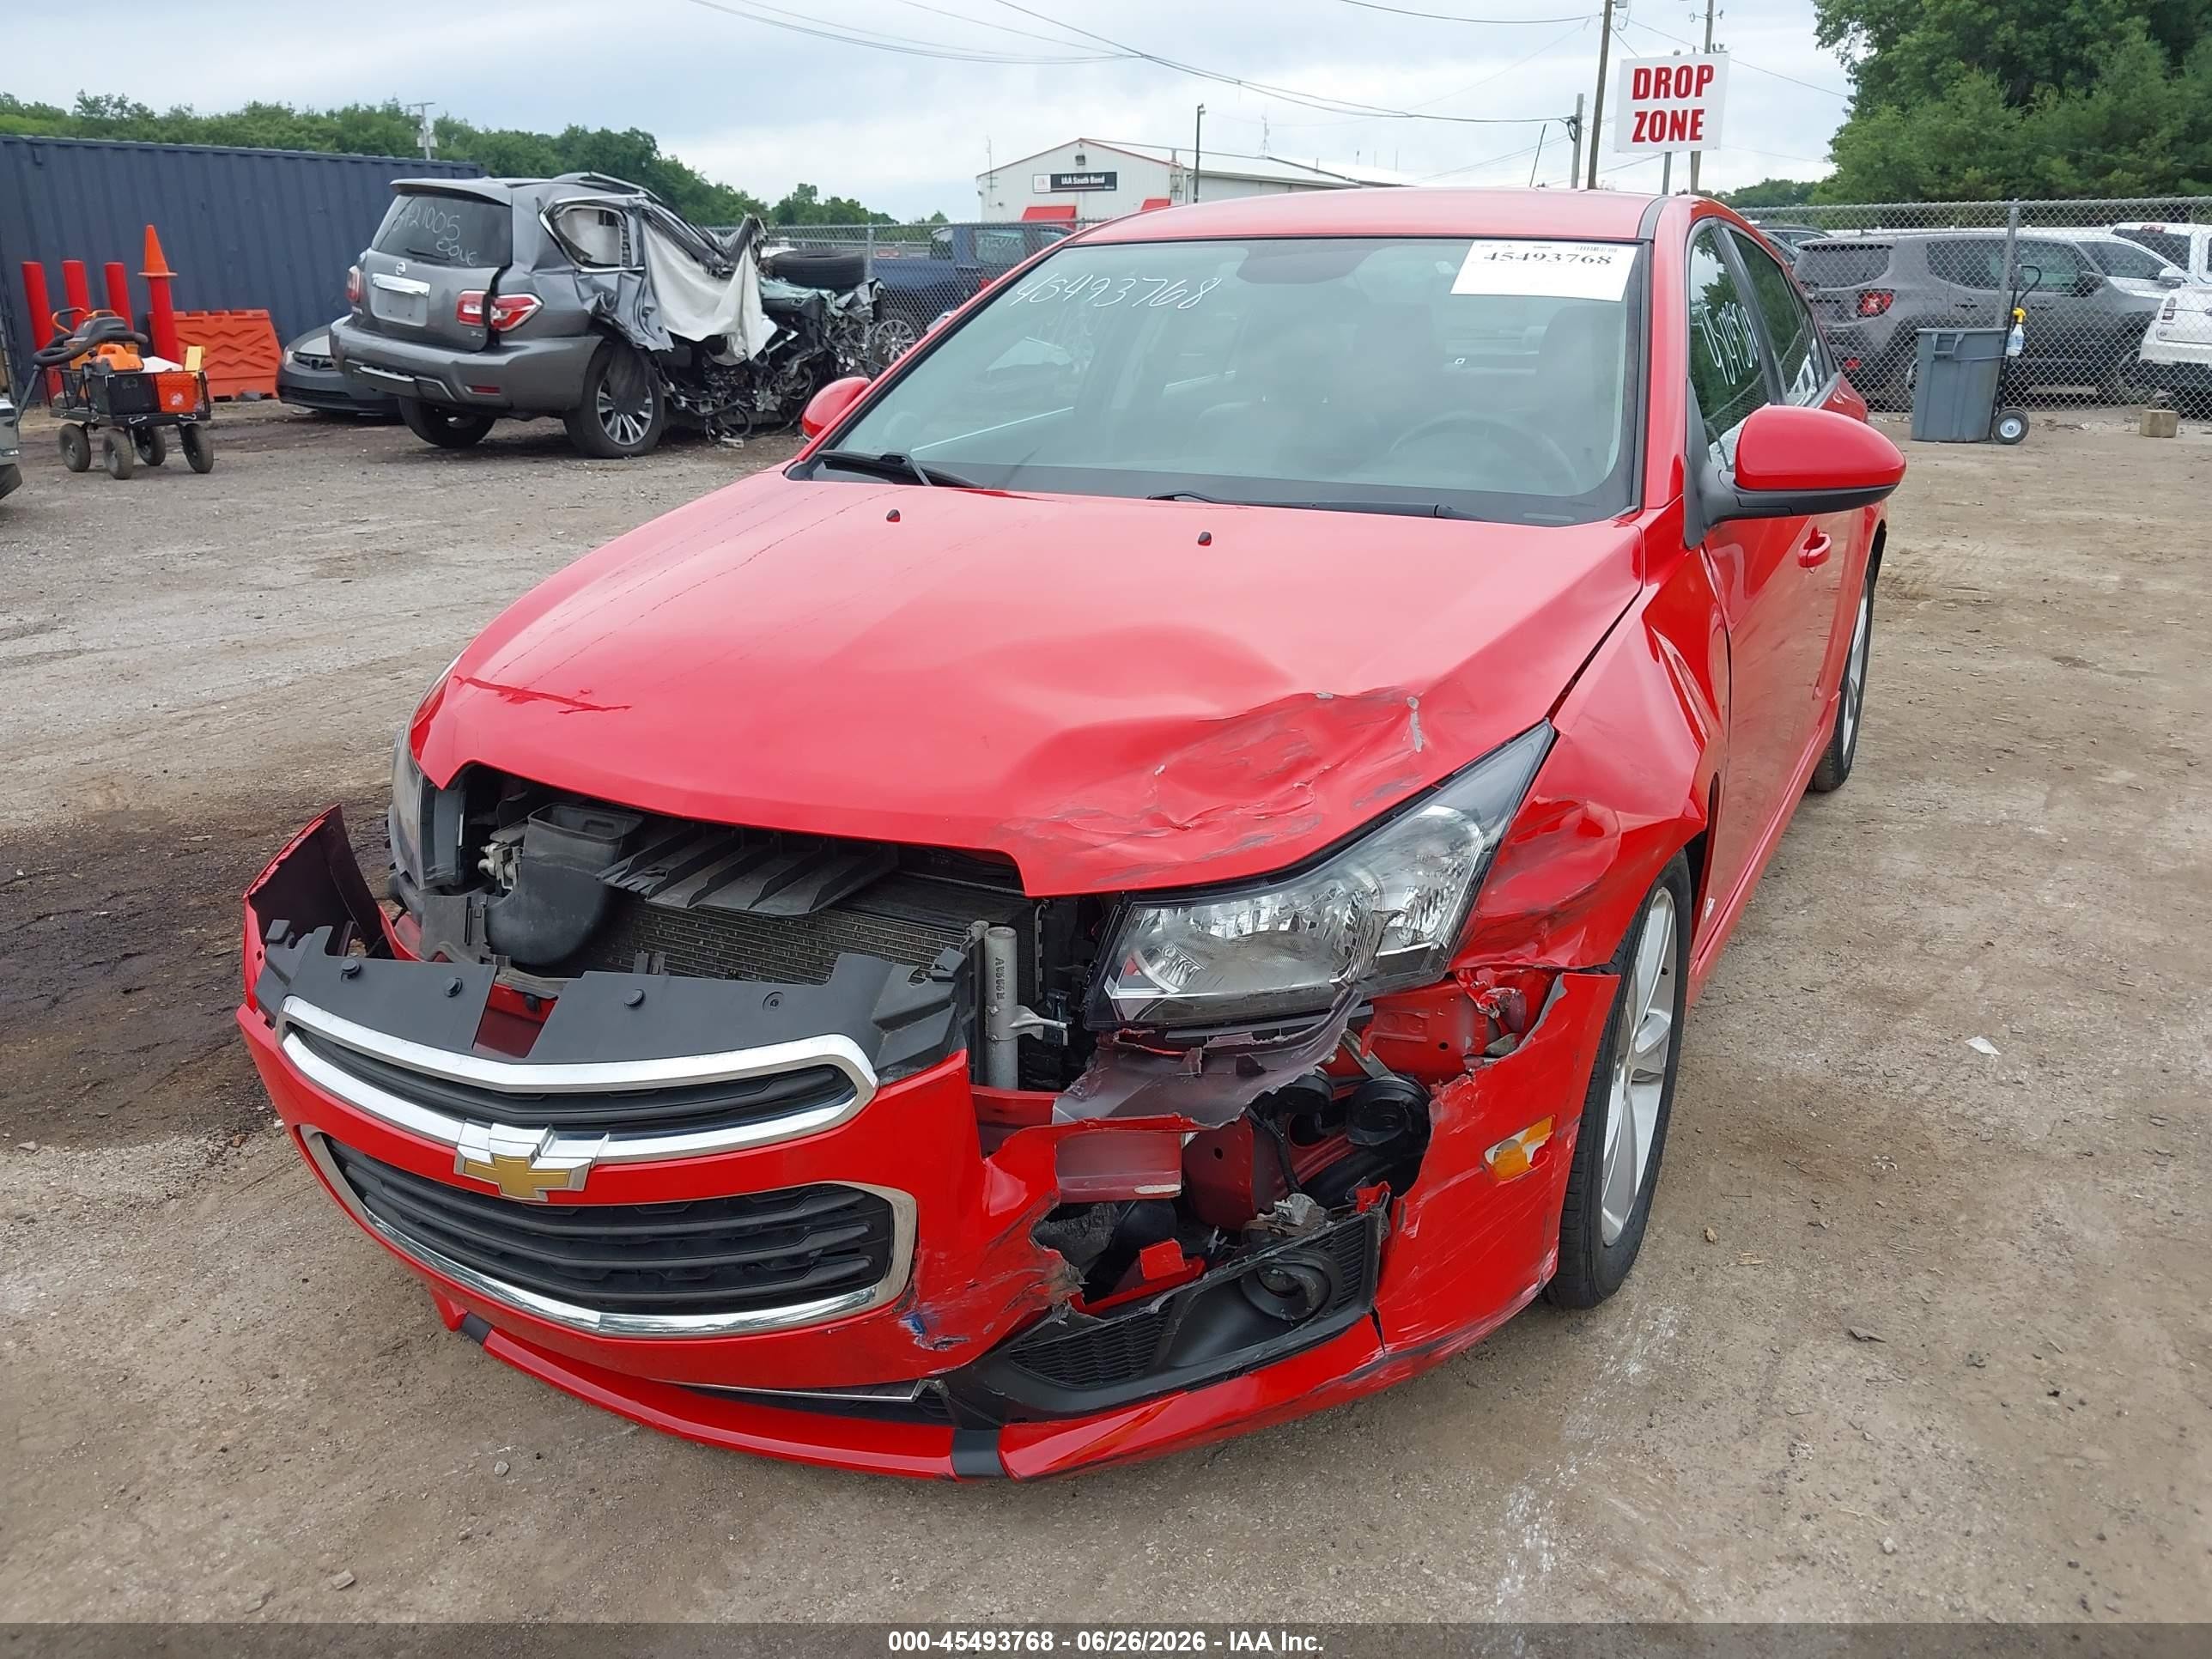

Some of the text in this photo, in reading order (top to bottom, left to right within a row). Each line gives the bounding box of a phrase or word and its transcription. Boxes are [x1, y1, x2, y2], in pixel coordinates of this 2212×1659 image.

[1632, 64, 1714, 100] DROP
[1632, 109, 1705, 143] ZONE
[1483, 252, 1612, 265] 45493768
[1010, 273, 1222, 309] 45493768
